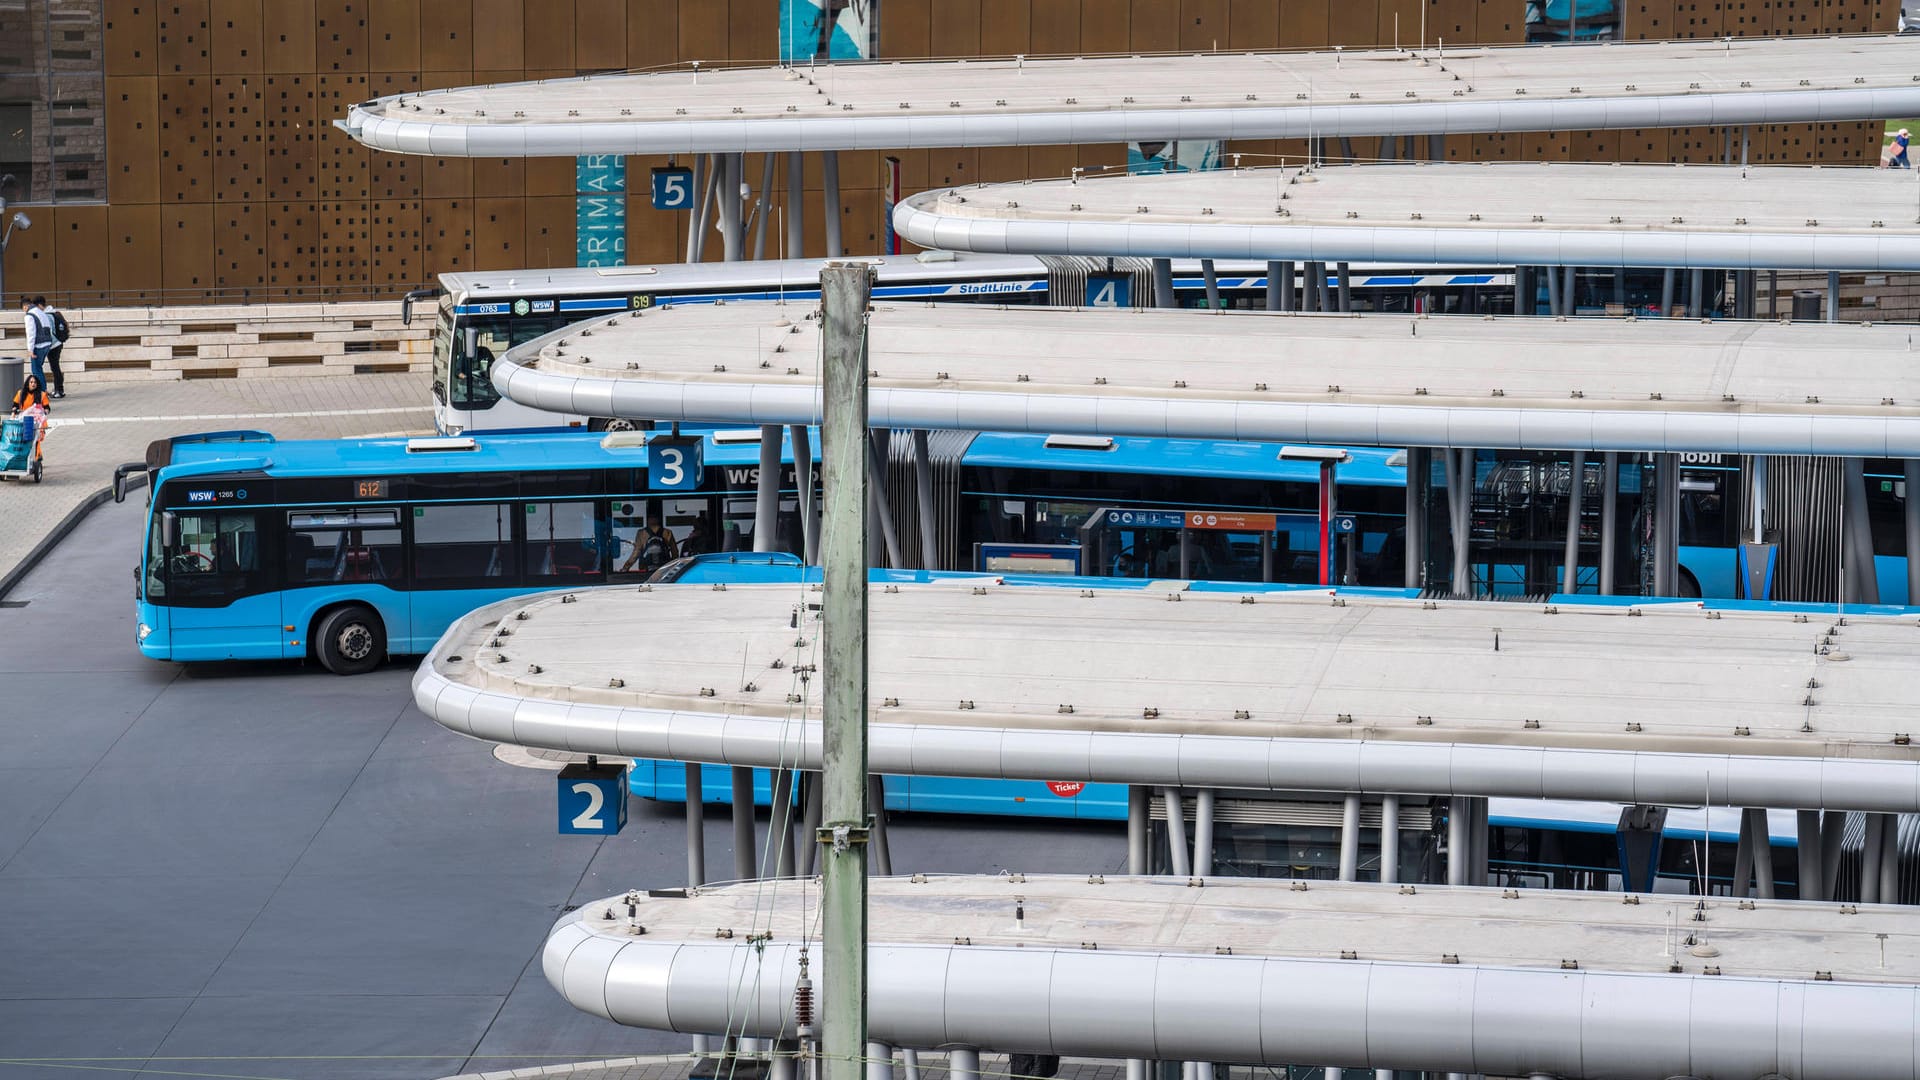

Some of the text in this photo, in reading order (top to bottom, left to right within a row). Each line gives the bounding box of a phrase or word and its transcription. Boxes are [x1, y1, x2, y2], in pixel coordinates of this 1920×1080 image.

[665, 176, 685, 206] 5
[960, 283, 1022, 293] StadtLinie
[1093, 281, 1117, 307] 4
[633, 296, 649, 308] 619
[480, 305, 498, 313] 0763
[660, 449, 684, 485] 3
[360, 482, 379, 496] 612
[190, 491, 212, 501] WSW
[1054, 783, 1081, 792] Ticket
[572, 782, 604, 829] 2
